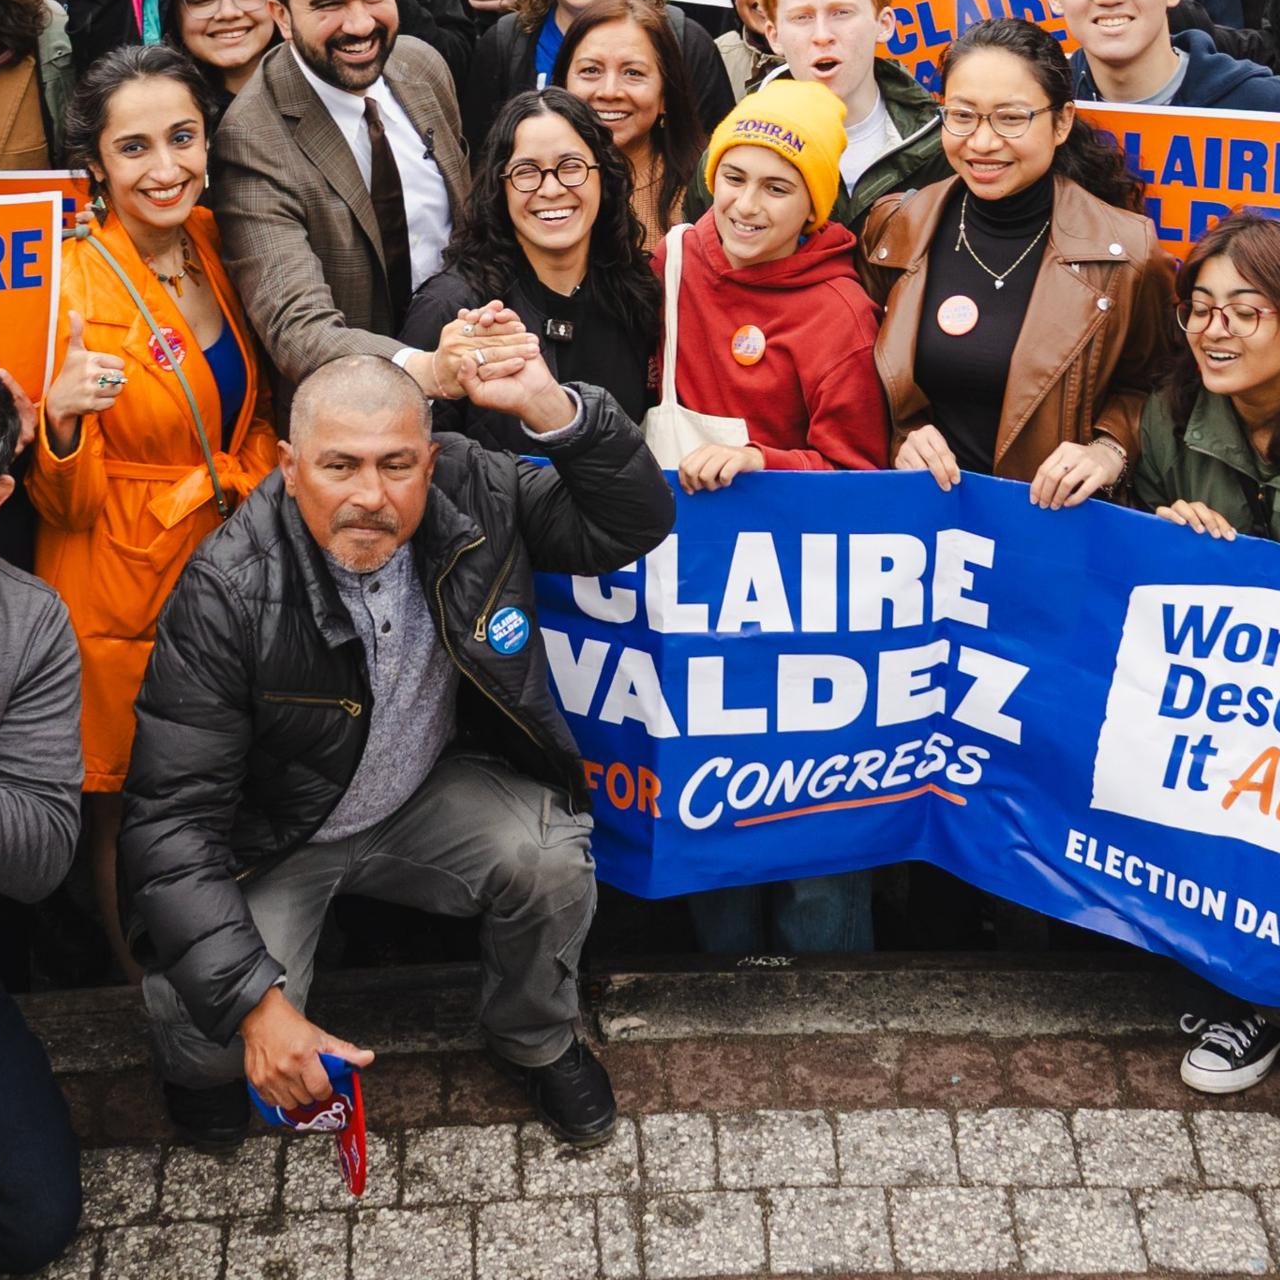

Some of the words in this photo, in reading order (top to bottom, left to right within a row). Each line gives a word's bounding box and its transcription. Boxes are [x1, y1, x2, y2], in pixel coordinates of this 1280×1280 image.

[735, 119, 806, 153] ZOHRAN
[539, 627, 1031, 746] VALDEZ
[583, 760, 662, 819] FOR
[1161, 733, 1219, 792] It
[1064, 828, 1227, 922] ELECTION
